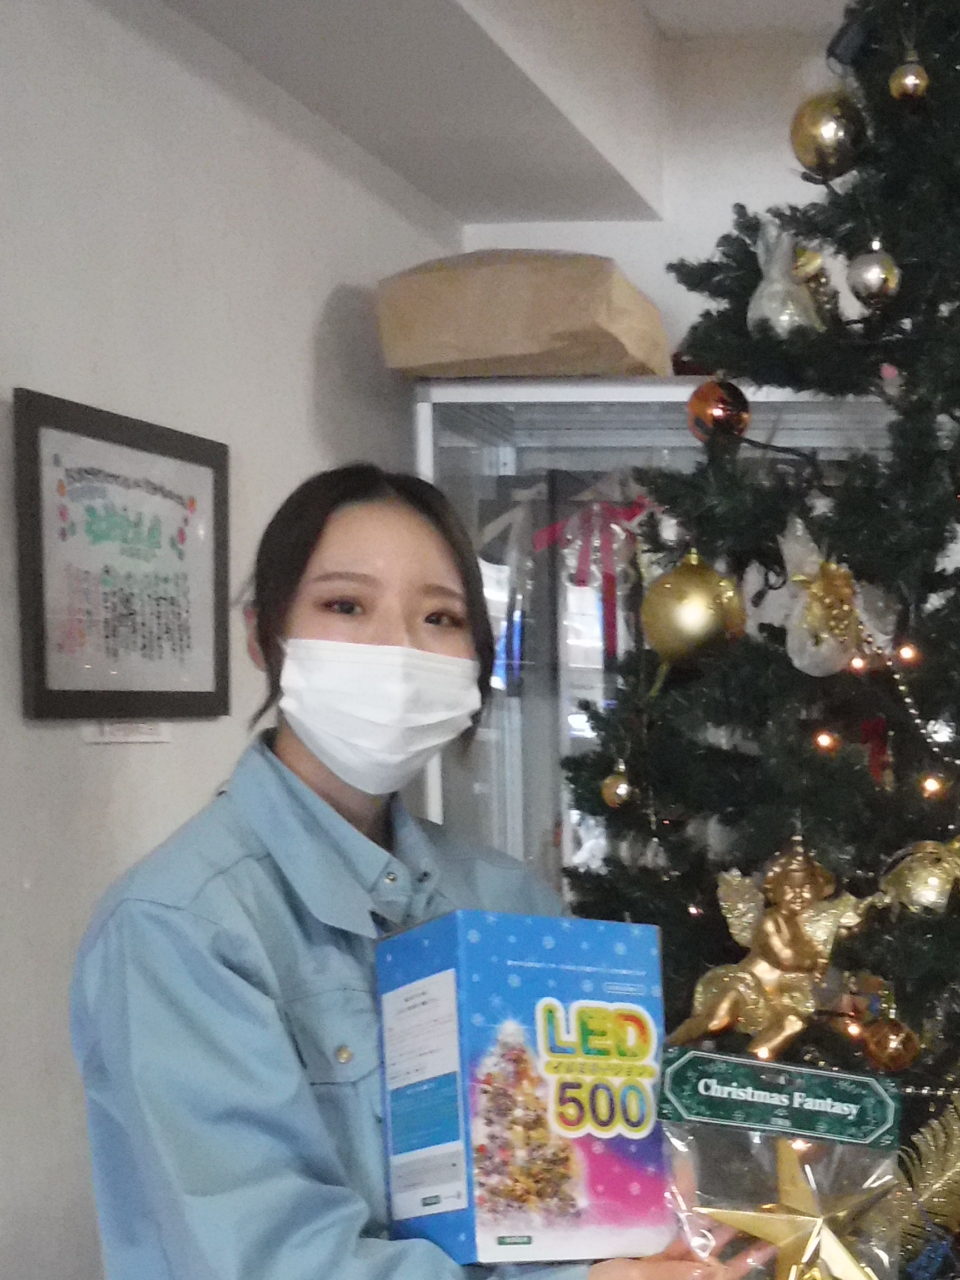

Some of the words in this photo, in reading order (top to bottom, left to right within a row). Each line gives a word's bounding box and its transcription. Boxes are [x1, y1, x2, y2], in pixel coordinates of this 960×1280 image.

[543, 1004, 654, 1060] LED
[557, 1081, 648, 1128] 500
[697, 1077, 790, 1106] Christmas
[791, 1091, 862, 1120] Fantasy
